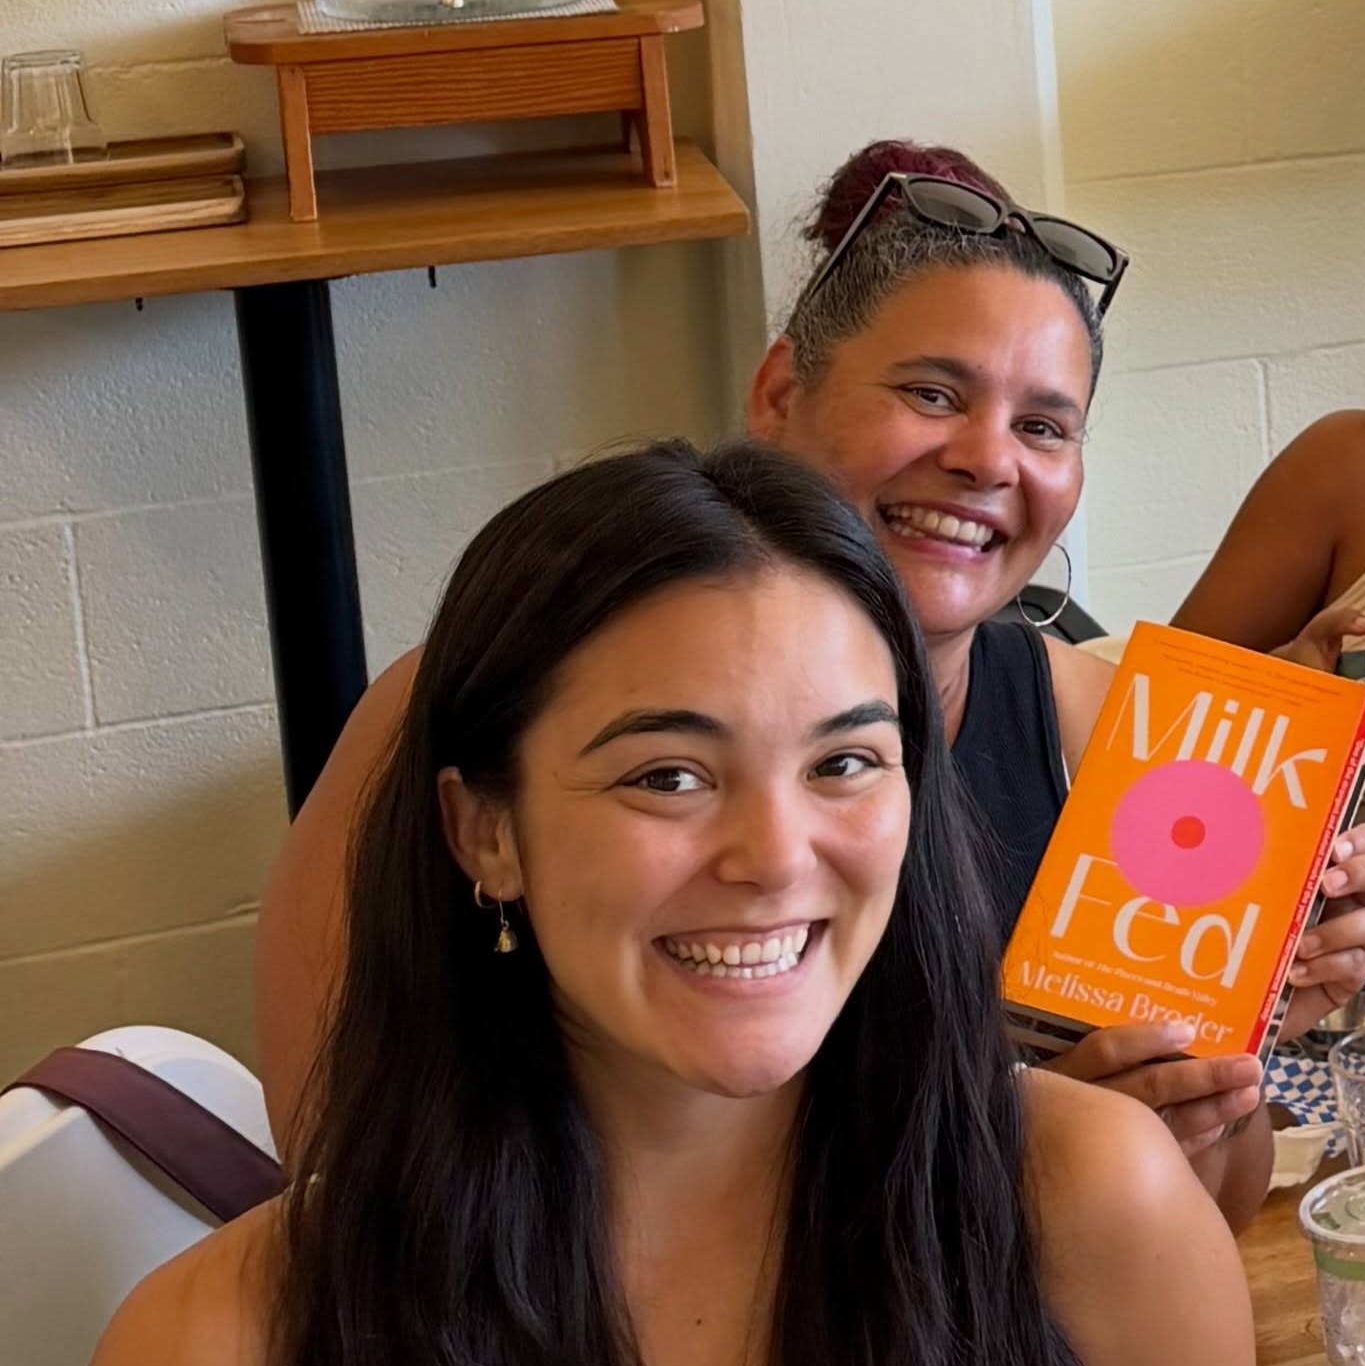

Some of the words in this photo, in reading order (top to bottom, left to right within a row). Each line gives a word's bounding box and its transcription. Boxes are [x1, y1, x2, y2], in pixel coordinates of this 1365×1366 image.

[1106, 673, 1327, 810] Milk
[1049, 852, 1261, 990] Fed
[1019, 960, 1125, 1013] Melissa
[1129, 992, 1233, 1044] Broder
